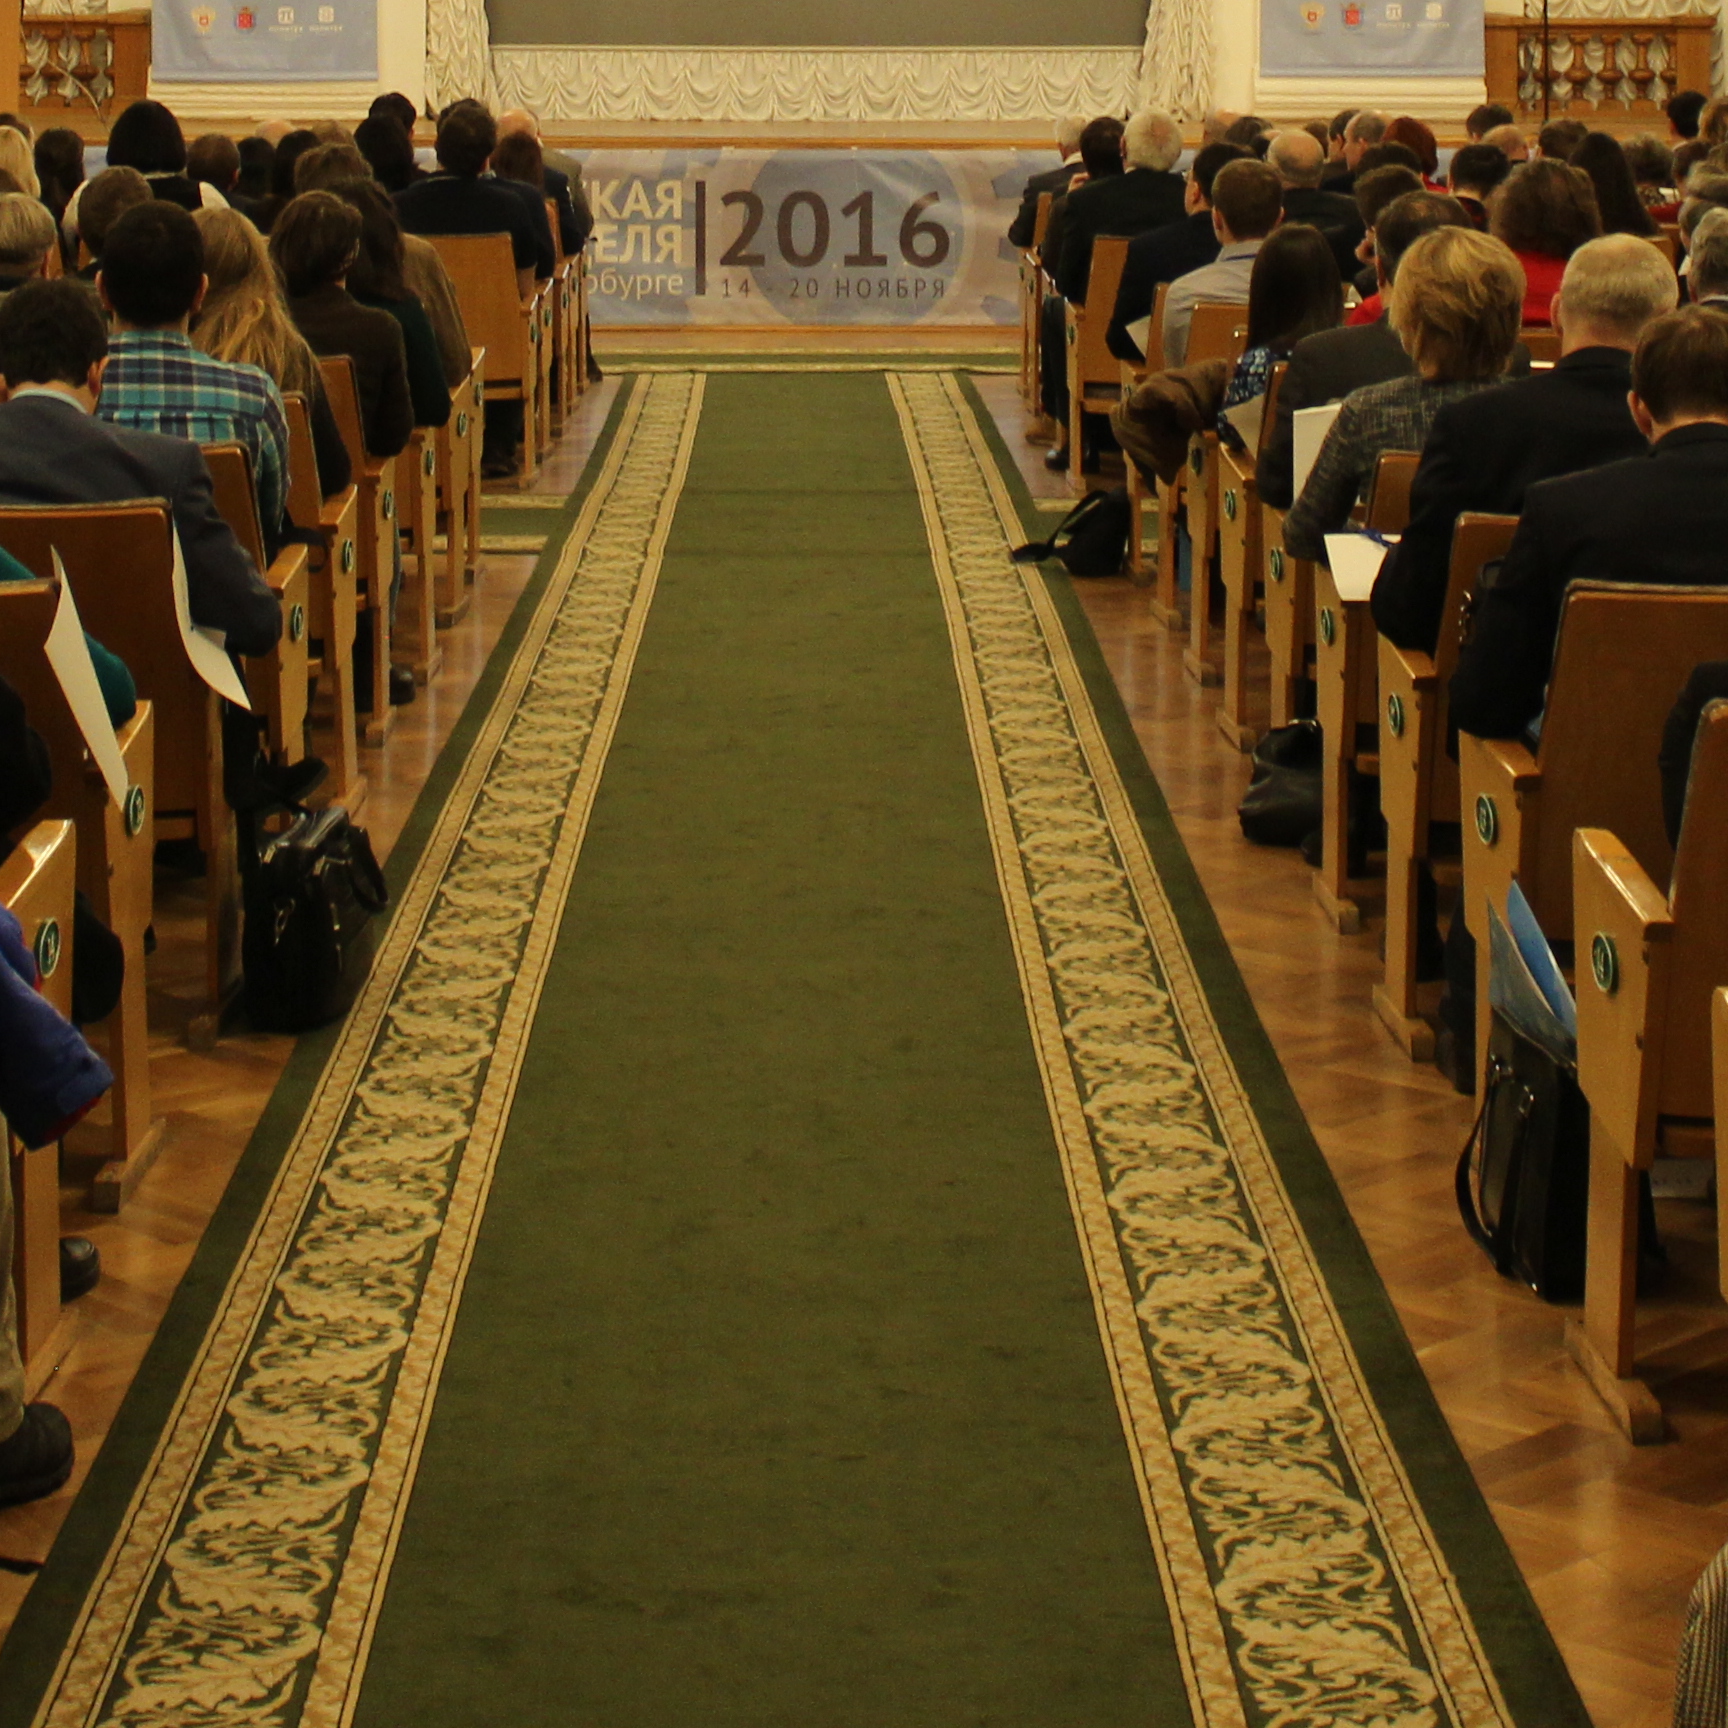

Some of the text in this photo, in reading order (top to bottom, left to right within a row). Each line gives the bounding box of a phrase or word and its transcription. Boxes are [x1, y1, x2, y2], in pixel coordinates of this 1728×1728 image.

[582, 179, 683, 219] КАЯ
[587, 224, 683, 268] ЕЛЯ
[720, 190, 950, 268] 2016
[722, 278, 750, 298] 14
[789, 278, 819, 298] 20
[836, 278, 945, 298] НОЯБРЯ
